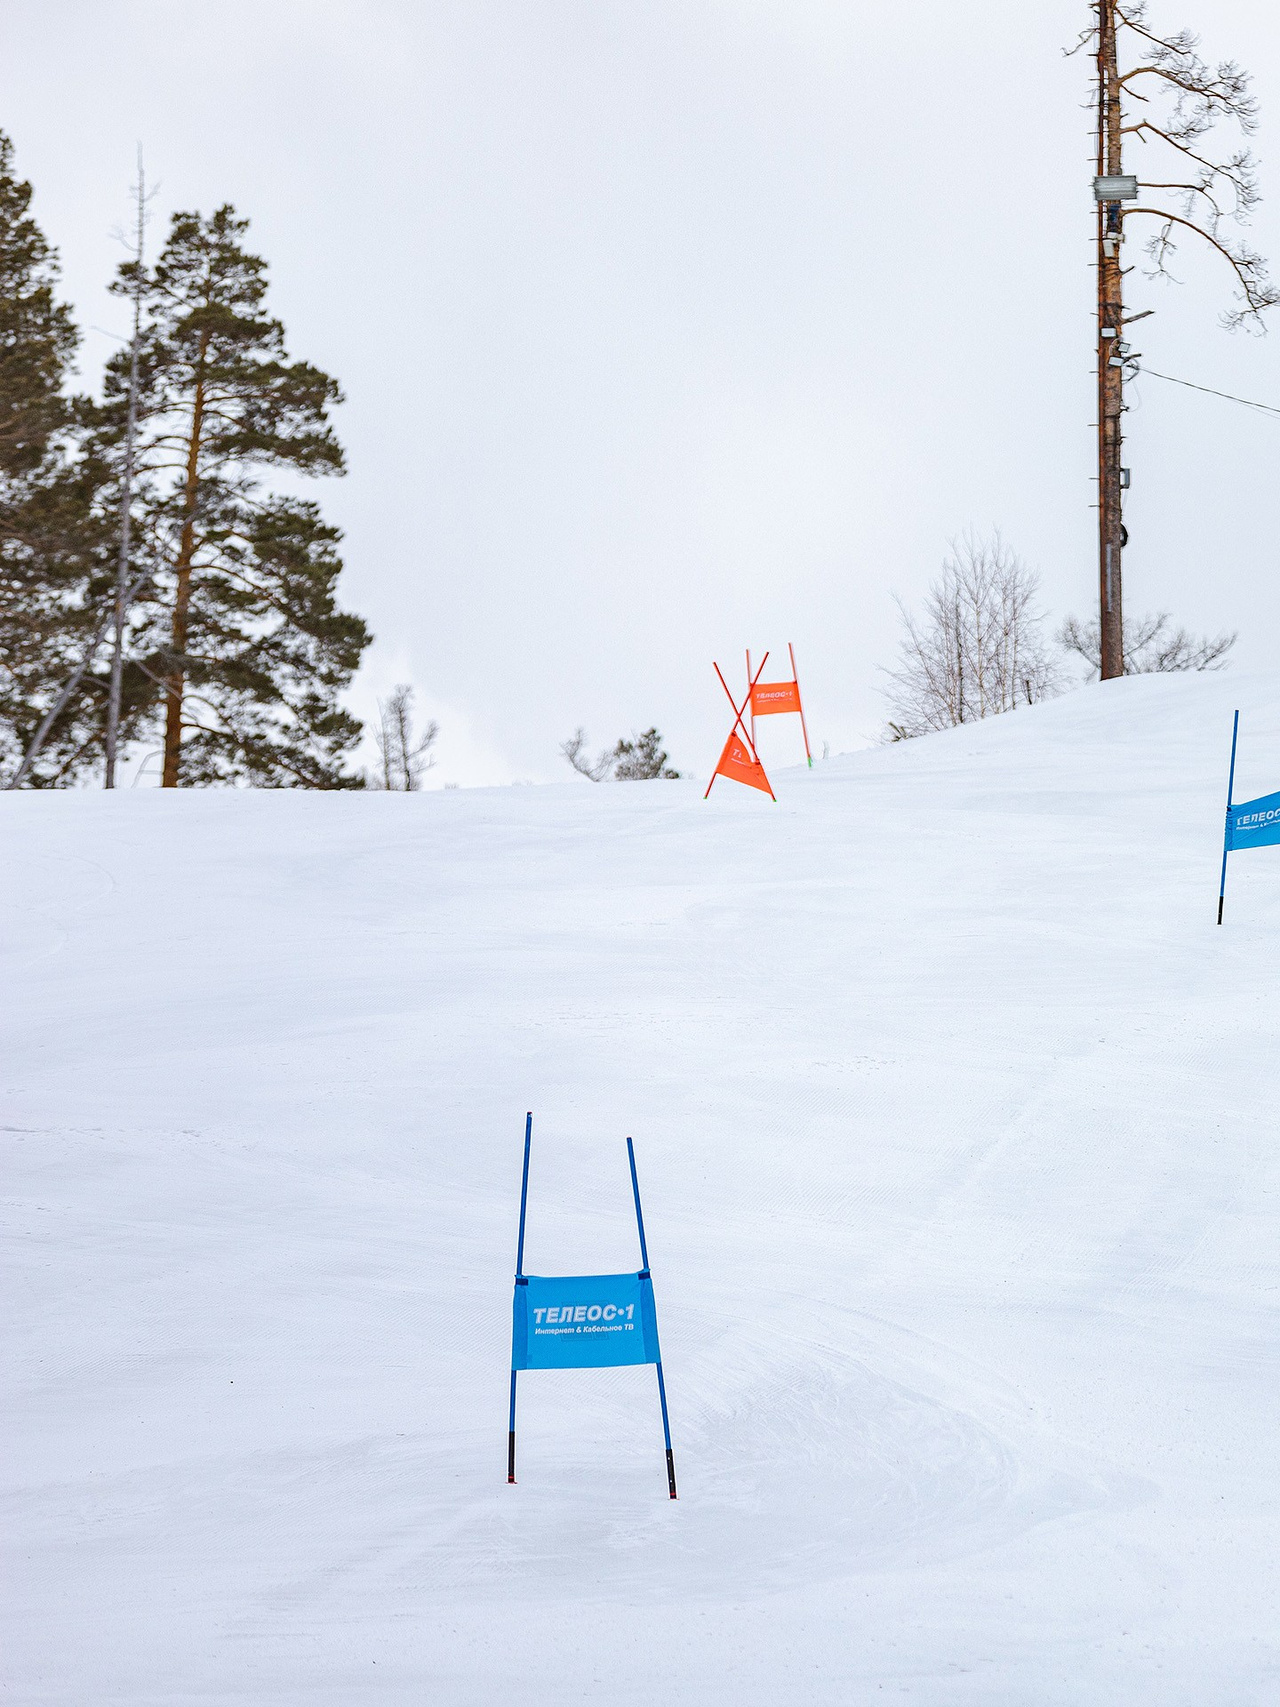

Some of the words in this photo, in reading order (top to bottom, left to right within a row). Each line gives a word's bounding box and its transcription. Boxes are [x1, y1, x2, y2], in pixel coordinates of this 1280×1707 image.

[534, 1327, 575, 1335] Интернет
[575, 1325, 582, 1333] &
[583, 1324, 623, 1333] Кабельное
[624, 1323, 634, 1331] ТВ
